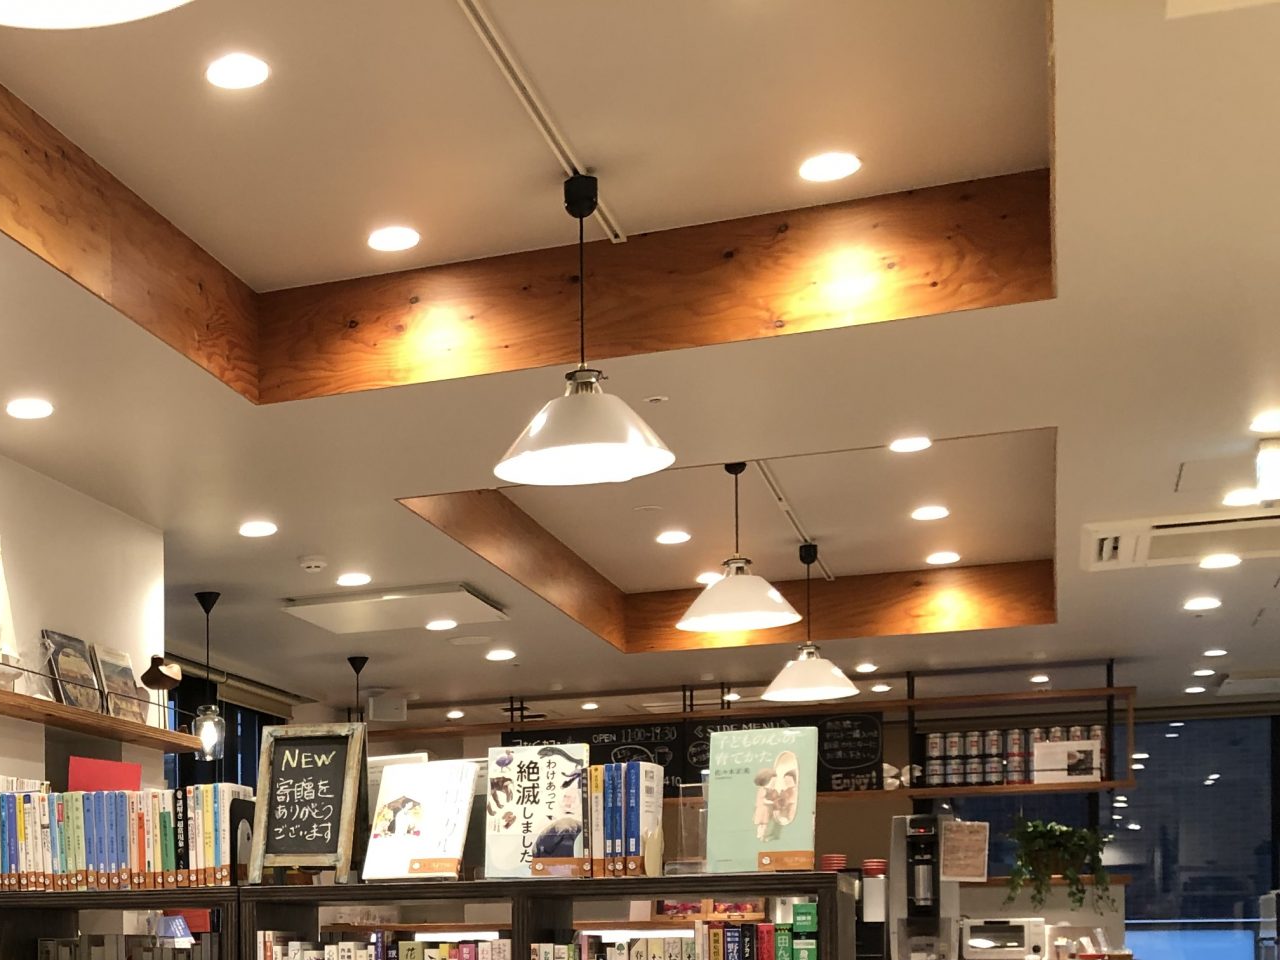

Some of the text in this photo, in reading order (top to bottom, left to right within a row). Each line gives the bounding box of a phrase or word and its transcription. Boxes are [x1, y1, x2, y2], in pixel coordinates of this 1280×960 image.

[592, 734, 616, 743] OPEN
[282, 749, 336, 771] NEW
[276, 777, 335, 802] 寄贈を
[545, 759, 556, 810] わけあって
[832, 770, 877, 790] Enjoy!
[275, 801, 334, 821] ありがとう
[516, 760, 540, 870] 絶滅しました。
[274, 822, 332, 843] ございます
